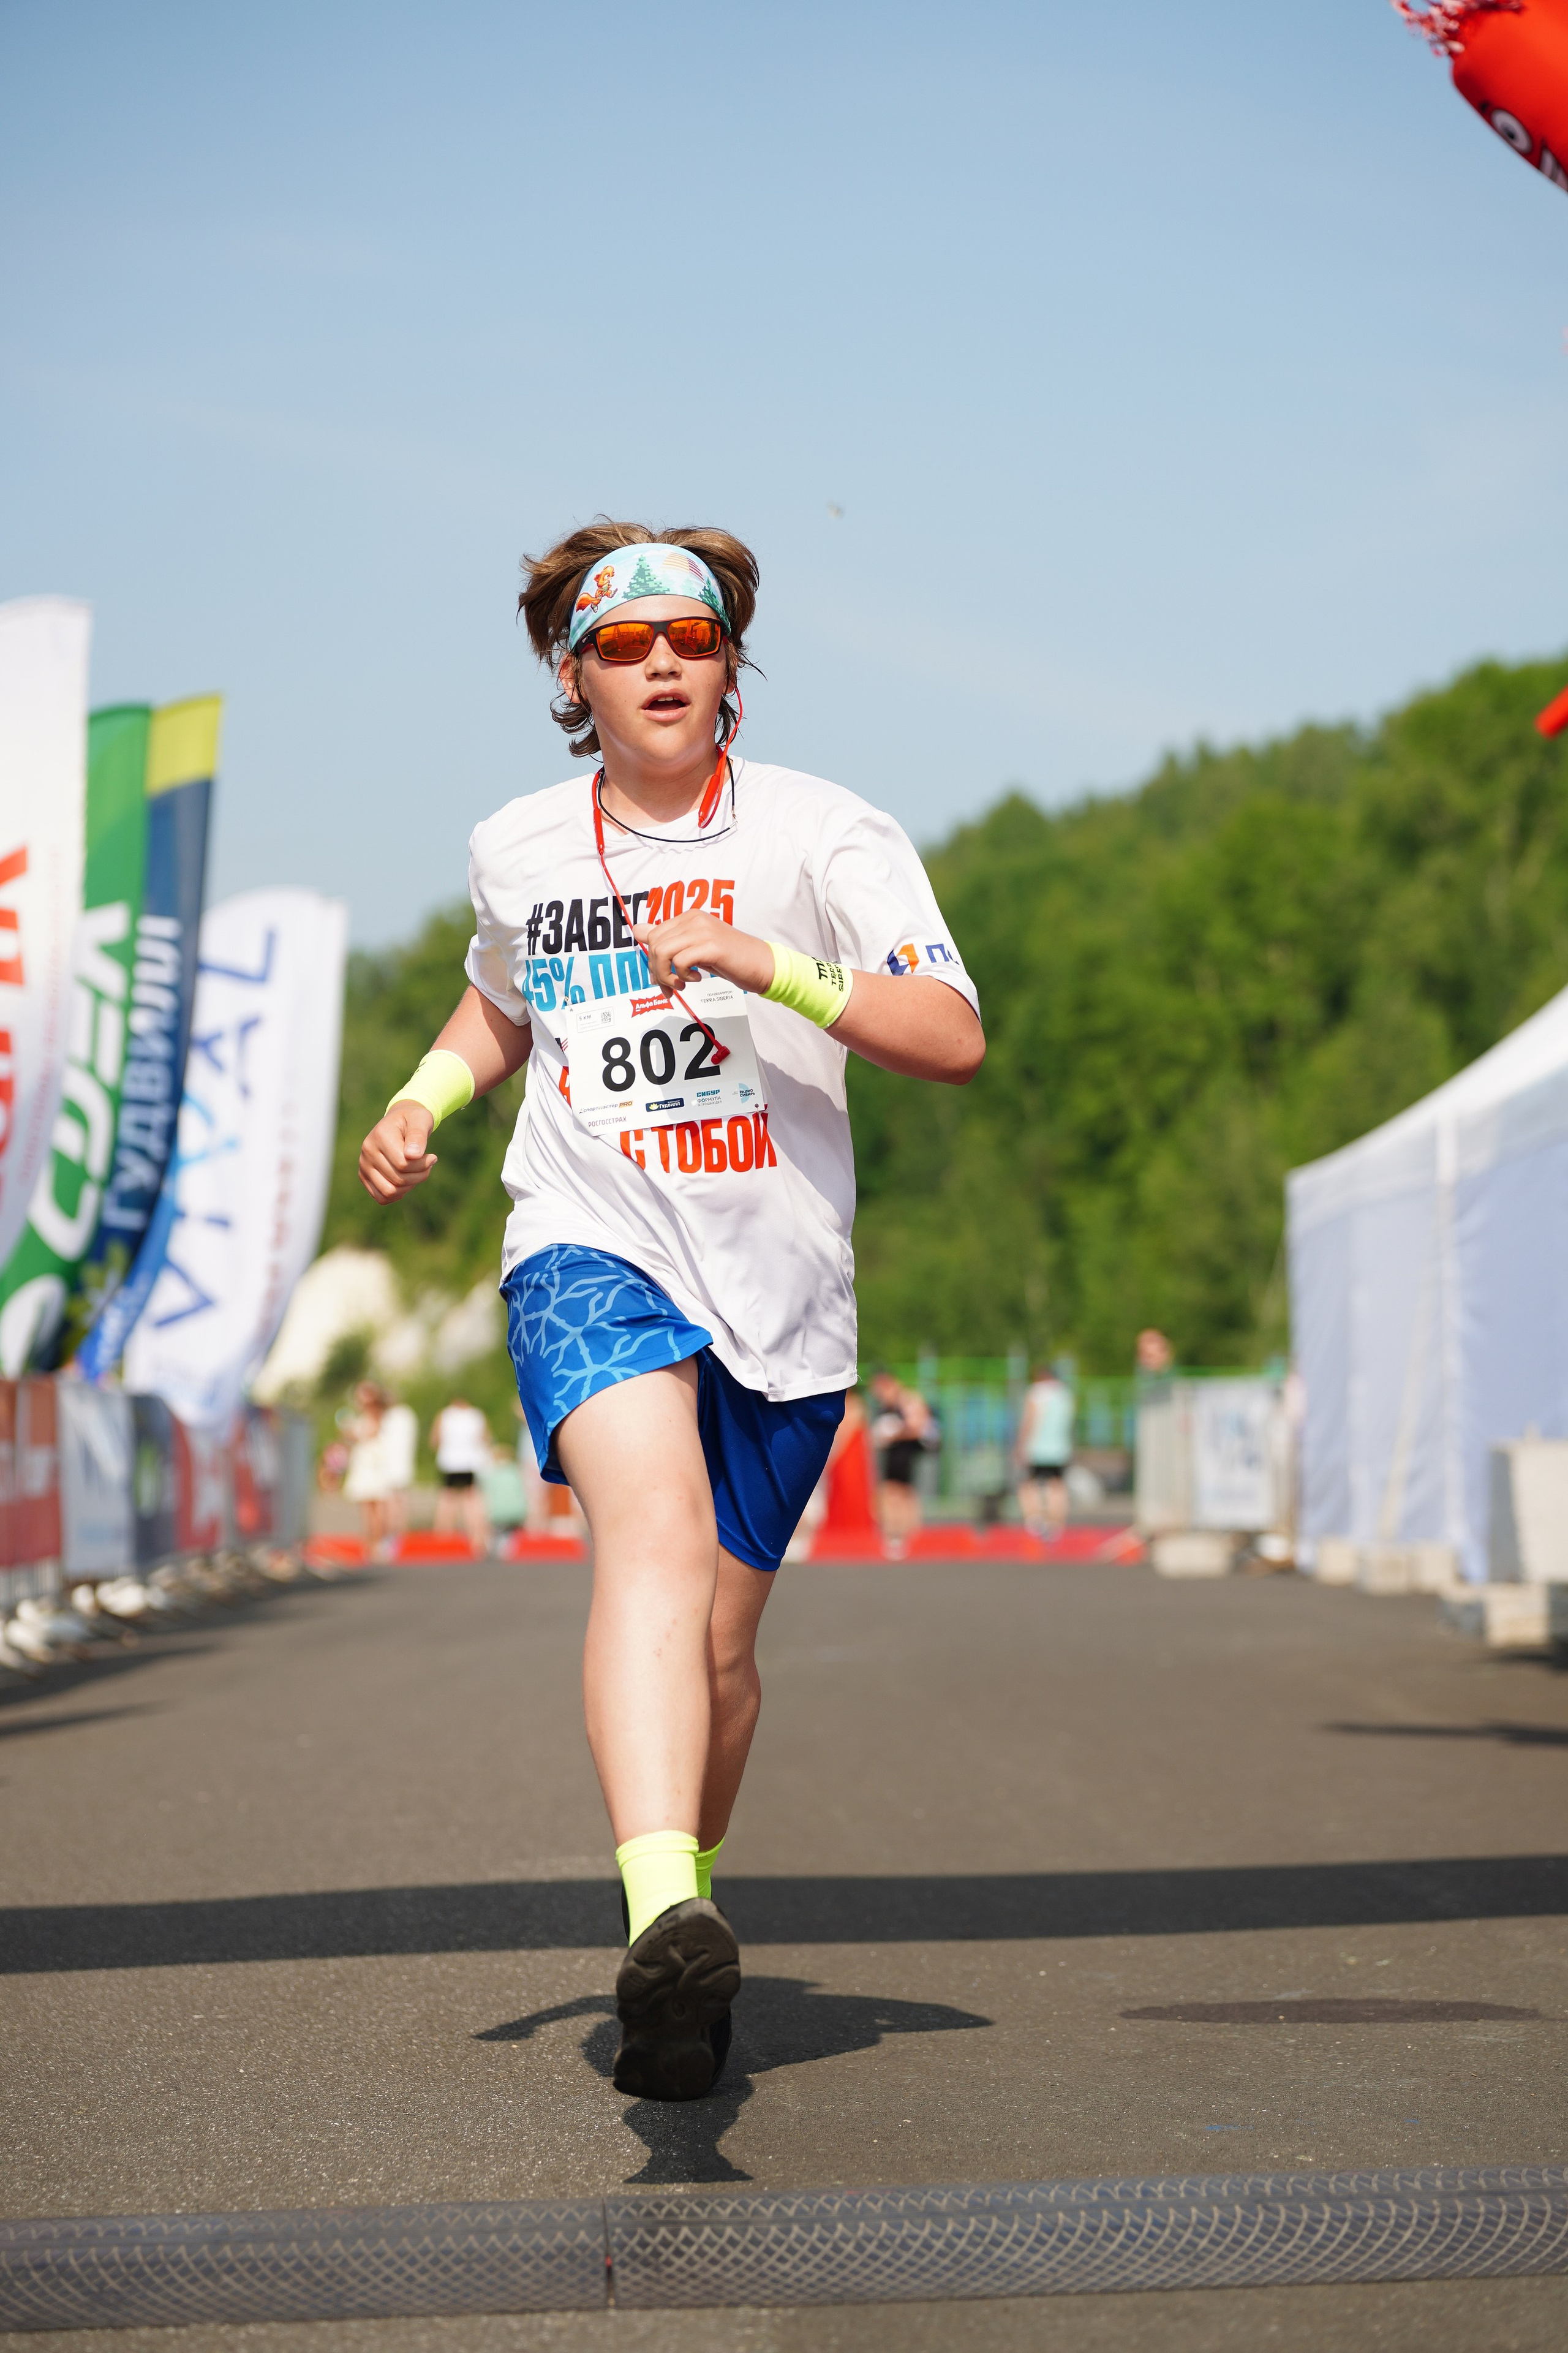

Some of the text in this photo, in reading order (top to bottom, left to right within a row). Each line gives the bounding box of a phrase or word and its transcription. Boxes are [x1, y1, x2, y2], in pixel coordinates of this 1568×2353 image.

[601, 1022, 721, 1092] 802
[588, 1116, 627, 1127] РОСГОССТРАХ
[650, 1105, 777, 1174] ТОБОЙ
